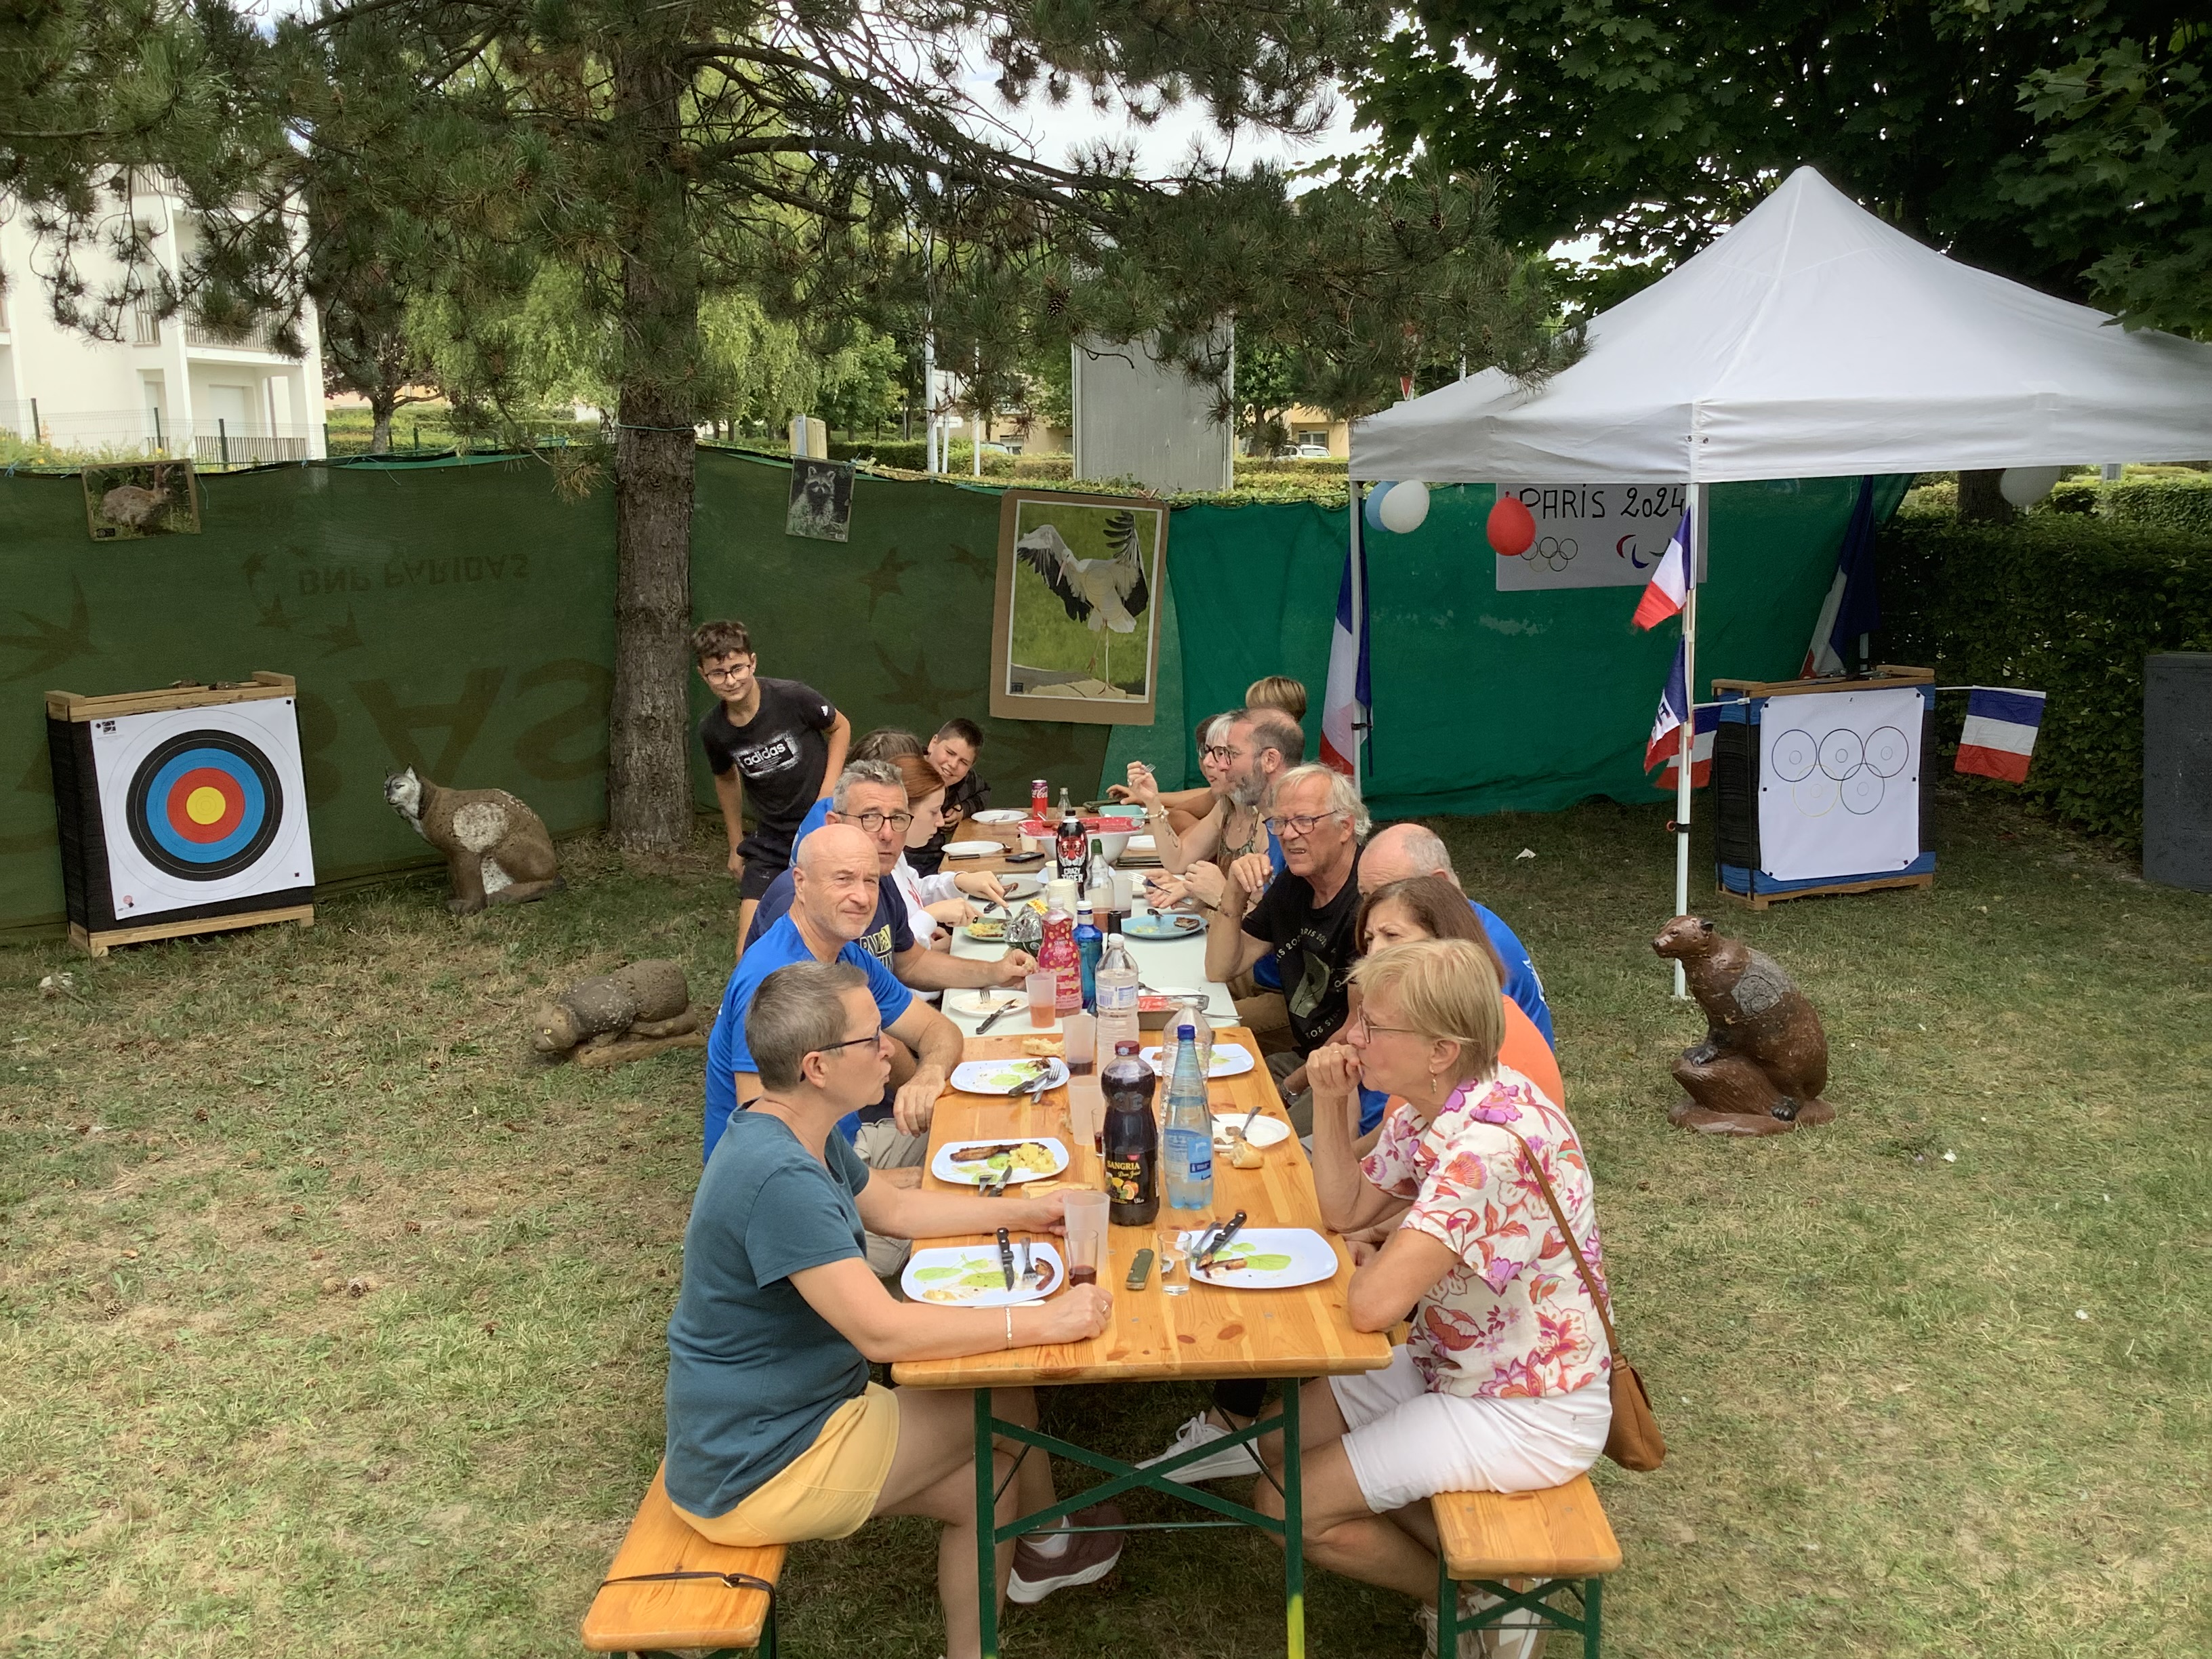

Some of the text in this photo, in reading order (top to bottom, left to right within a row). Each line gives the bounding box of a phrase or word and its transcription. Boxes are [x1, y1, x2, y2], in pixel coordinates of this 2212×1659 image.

[1620, 486, 1686, 518] 2024
[743, 743, 786, 766] adidas
[1063, 867, 1081, 875] CRAZY
[1061, 874, 1084, 882] TIGER
[1107, 1160, 1141, 1170] SANGRIA
